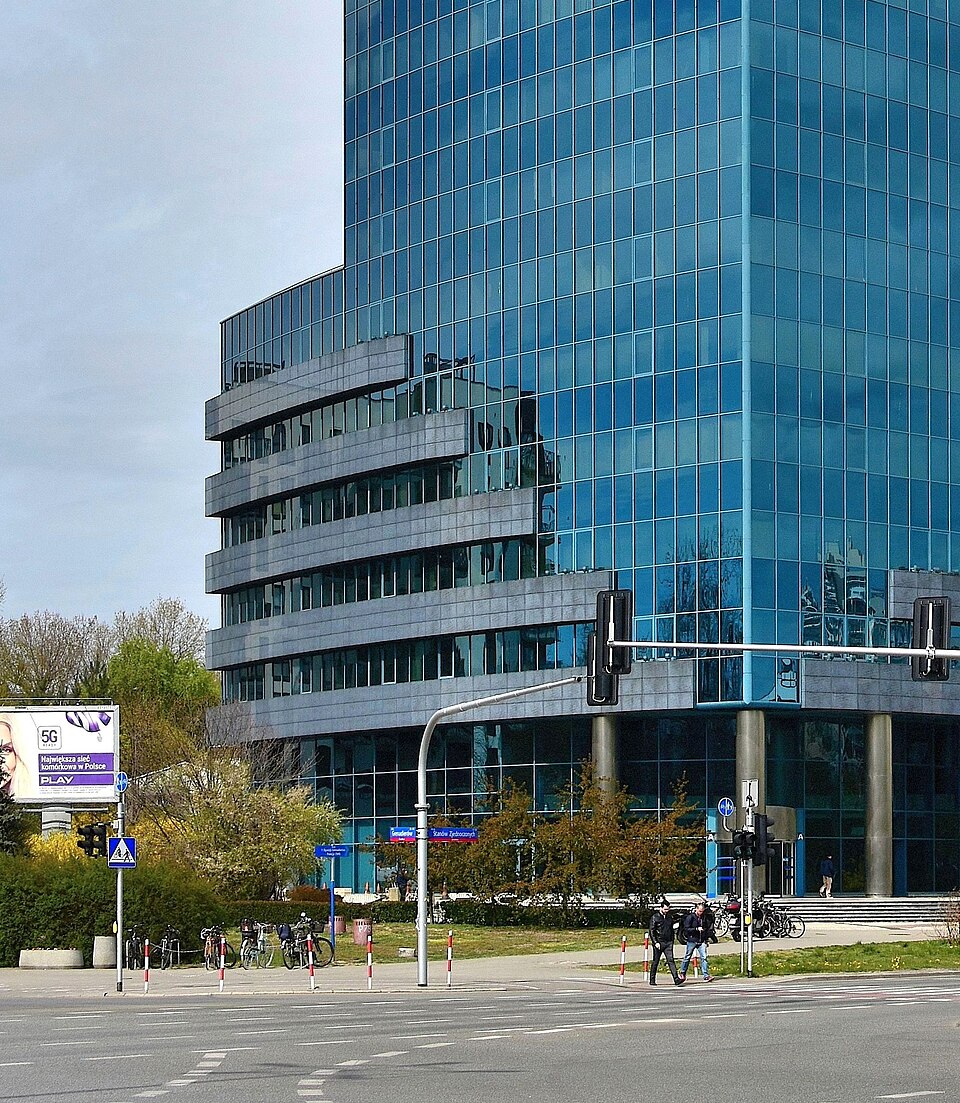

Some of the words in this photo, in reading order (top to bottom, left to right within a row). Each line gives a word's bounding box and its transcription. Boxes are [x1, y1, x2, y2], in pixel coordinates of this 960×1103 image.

[41, 729, 58, 743] 5G
[41, 755, 76, 764] Największa
[84, 762, 107, 770] Polsce
[40, 776, 74, 784] PLAY
